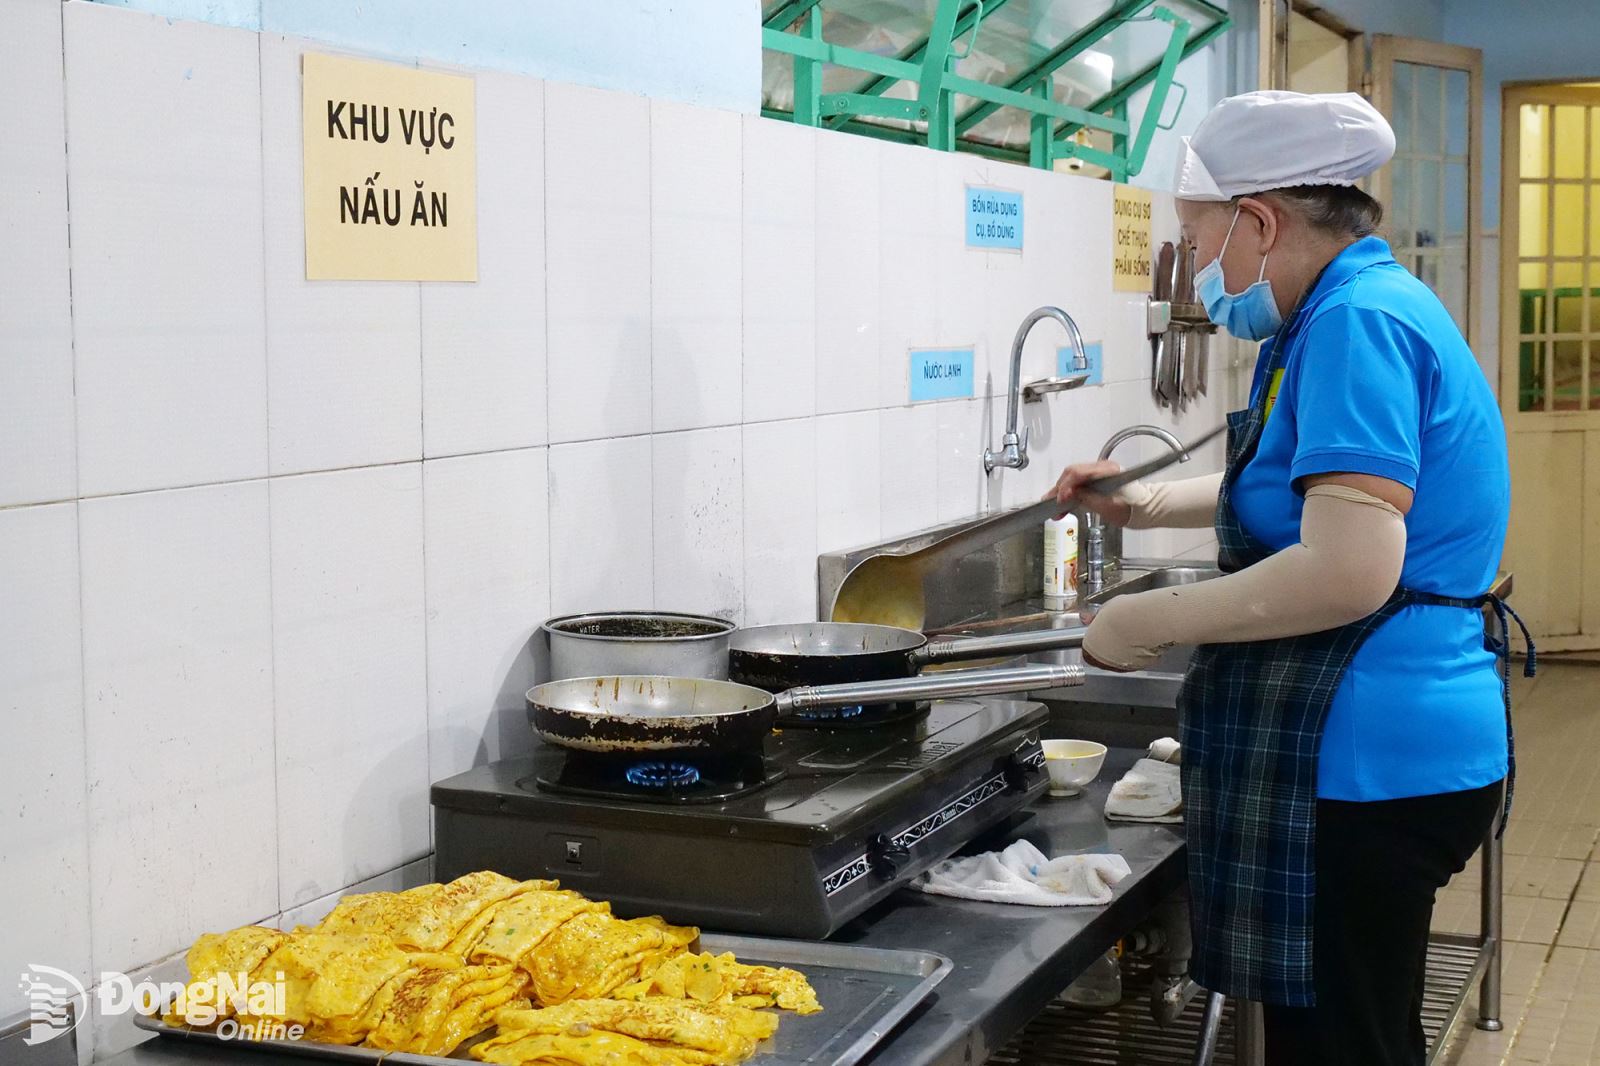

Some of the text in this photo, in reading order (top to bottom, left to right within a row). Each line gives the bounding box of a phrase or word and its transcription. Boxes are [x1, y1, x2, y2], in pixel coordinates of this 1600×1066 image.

[327, 99, 455, 155] KHU VỰC
[340, 171, 448, 228] NẤU ĂN
[579, 624, 601, 634] WATER
